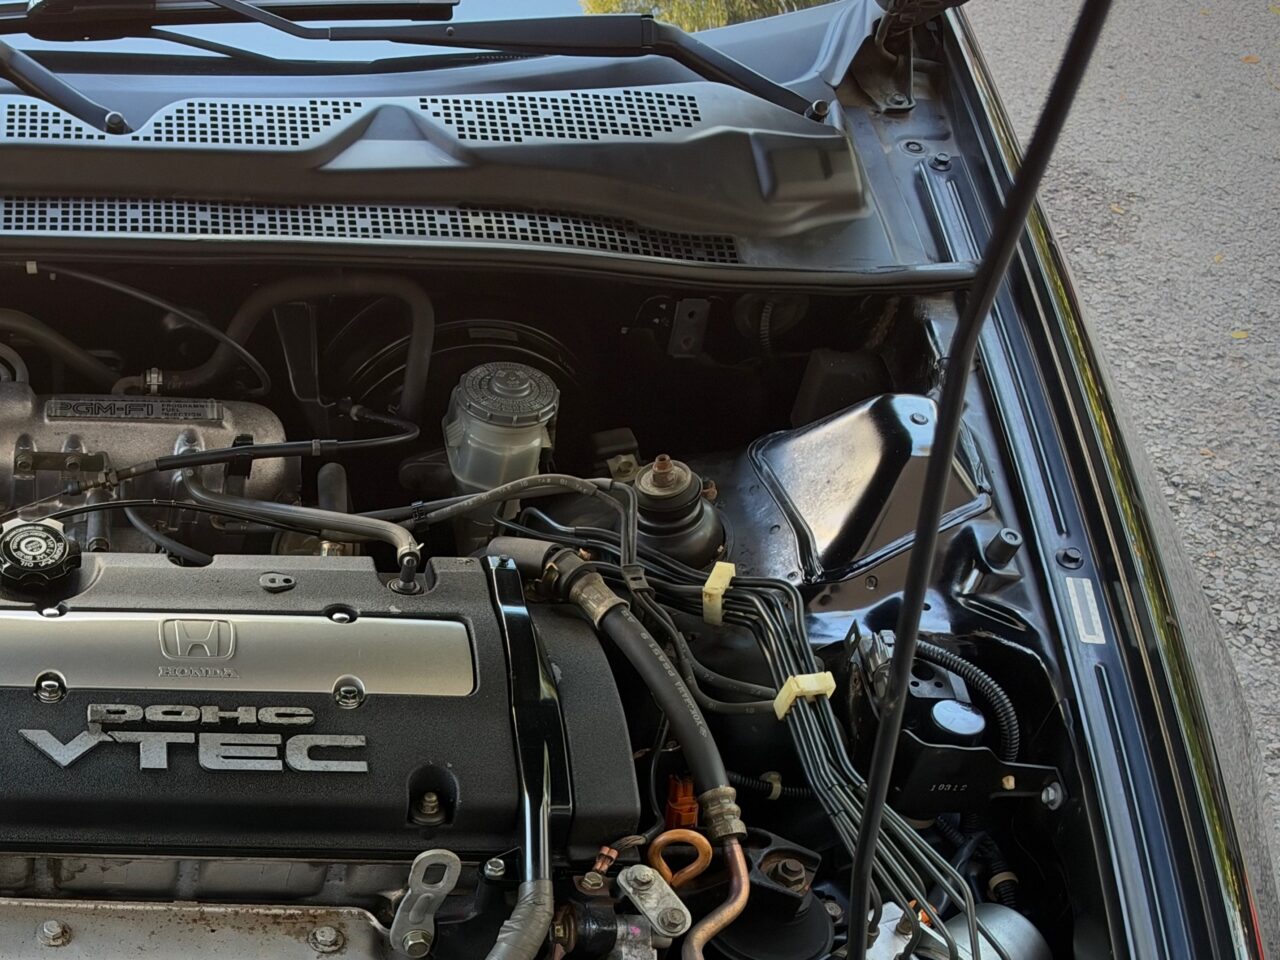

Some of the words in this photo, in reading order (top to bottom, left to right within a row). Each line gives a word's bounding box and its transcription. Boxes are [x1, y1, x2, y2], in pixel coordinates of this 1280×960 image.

[54, 402, 154, 416] PGM-FI
[157, 666, 241, 679] HONDA
[86, 703, 315, 726] DOHC
[18, 728, 369, 773] VTEC
